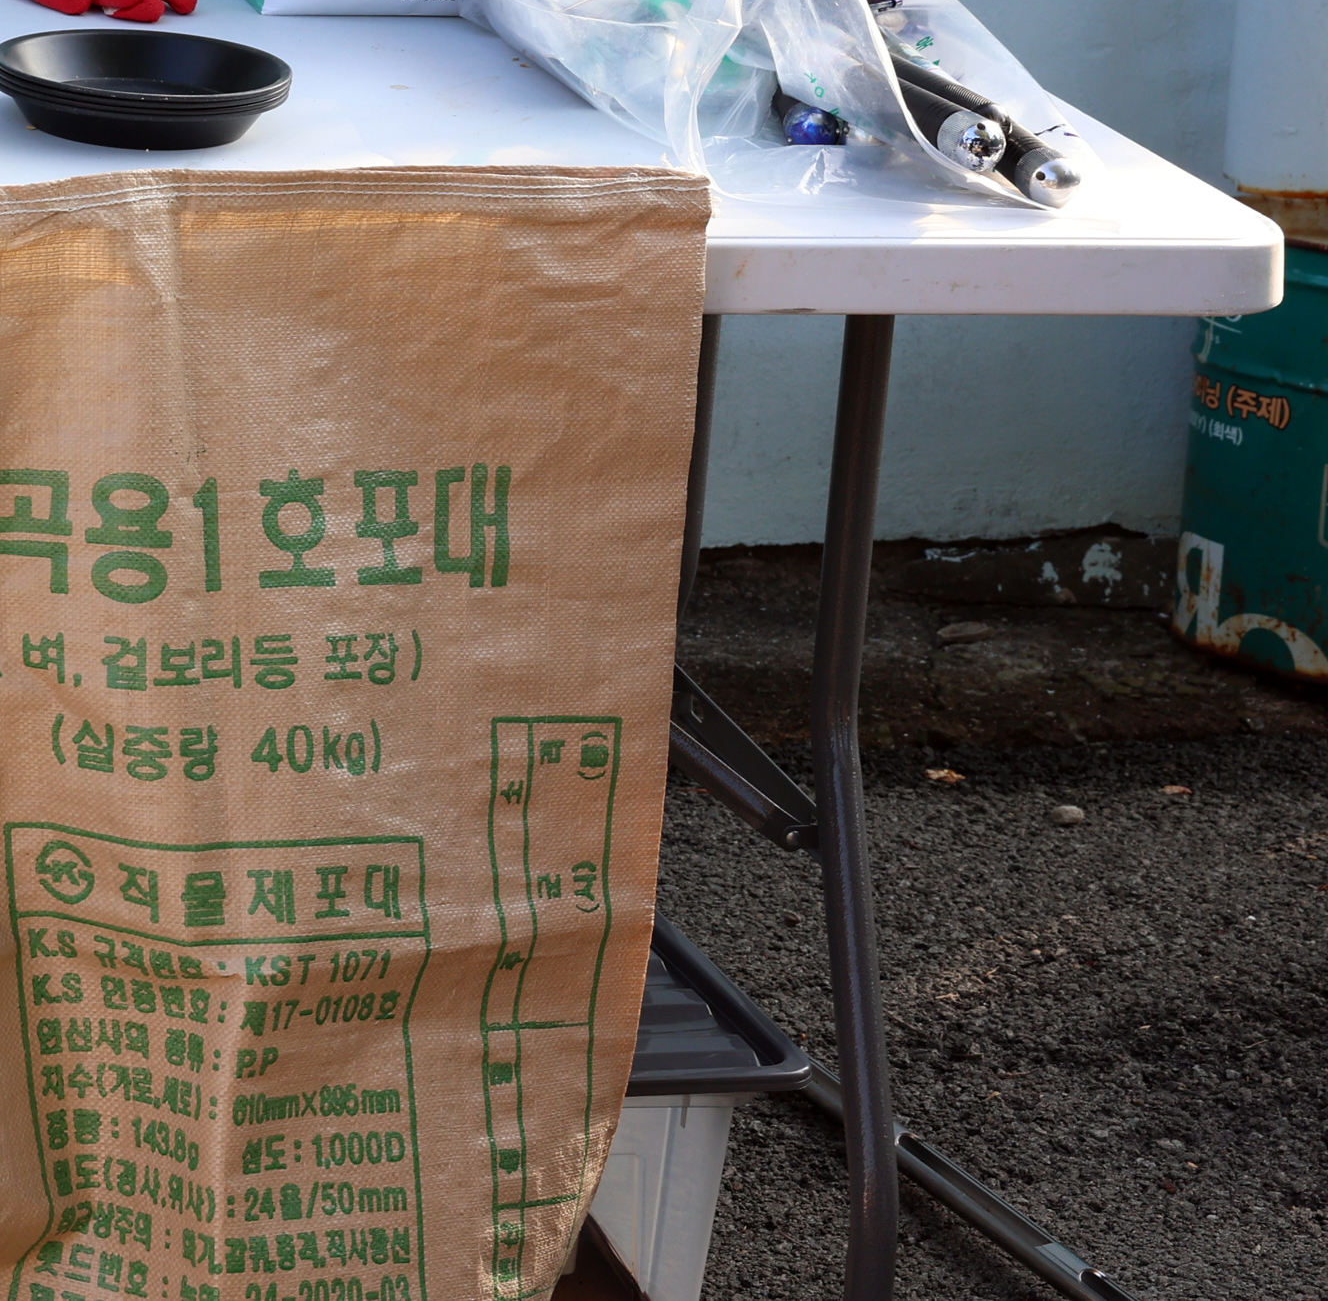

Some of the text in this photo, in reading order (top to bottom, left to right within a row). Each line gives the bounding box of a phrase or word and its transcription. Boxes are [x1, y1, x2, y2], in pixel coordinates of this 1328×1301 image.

[1227, 385, 1290, 429] (주제)
[258, 462, 513, 589] 호포대
[51, 713, 382, 782] (실중량 40kg)
[328, 949, 392, 984] 1071
